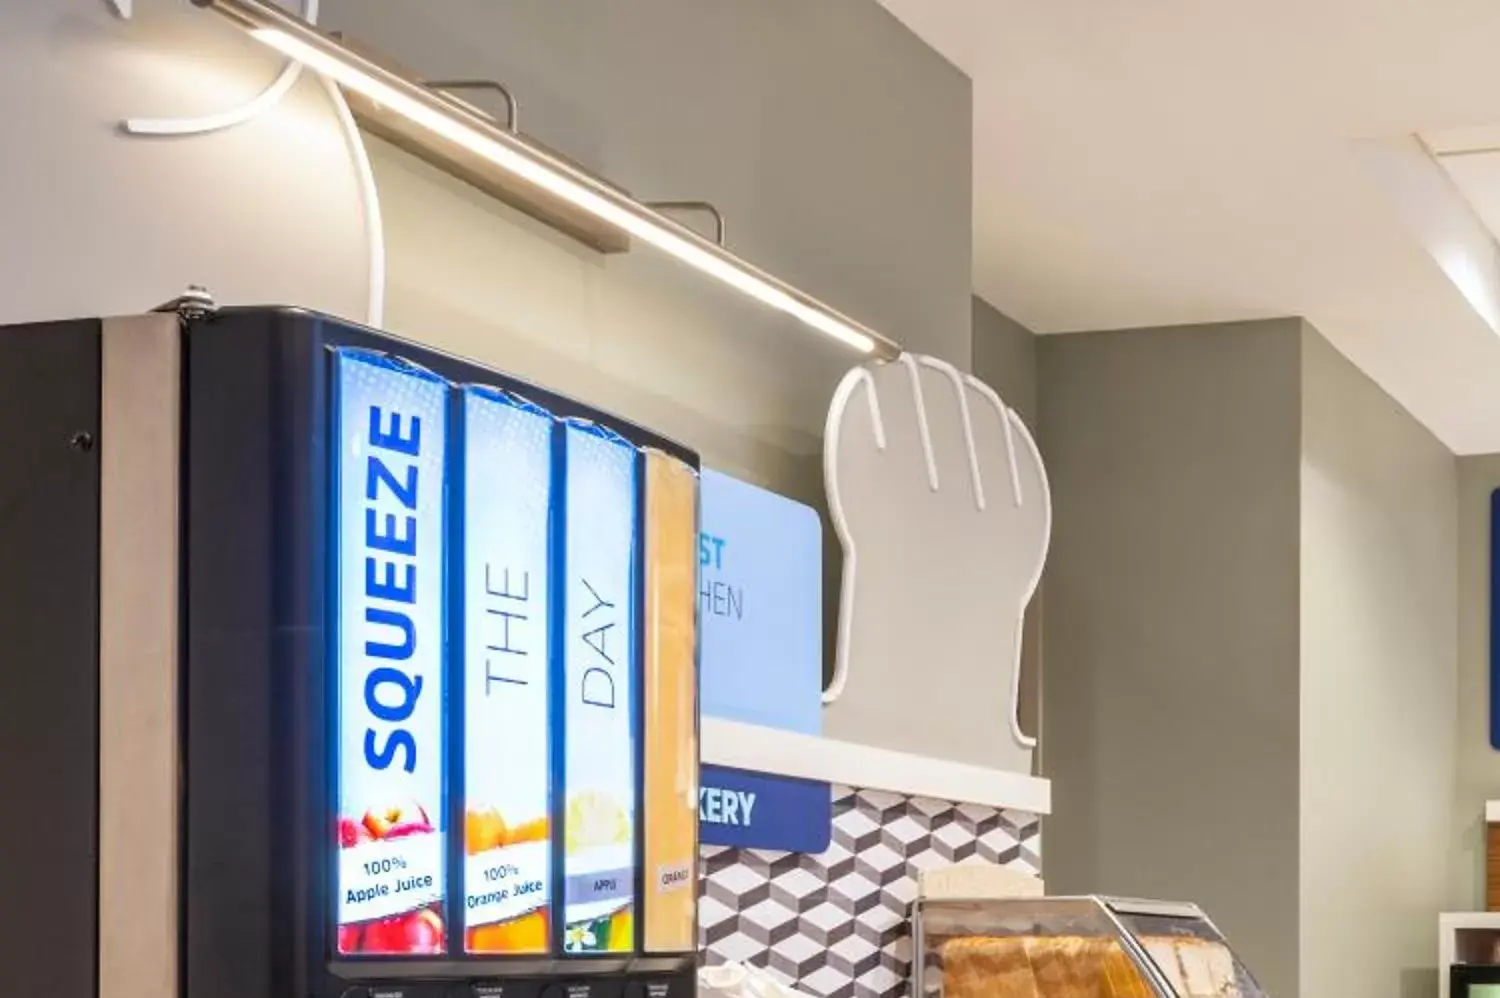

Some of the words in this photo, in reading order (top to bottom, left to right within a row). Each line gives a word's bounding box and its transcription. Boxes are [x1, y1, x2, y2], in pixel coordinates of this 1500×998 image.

[364, 405, 423, 774] SQUEEZE
[486, 562, 528, 697] THE
[582, 578, 615, 709] DAY
[346, 883, 389, 905] Apple
[394, 874, 433, 893] Juice
[363, 855, 407, 877] 100%
[467, 891, 509, 909] Orange
[513, 880, 543, 897] Juice
